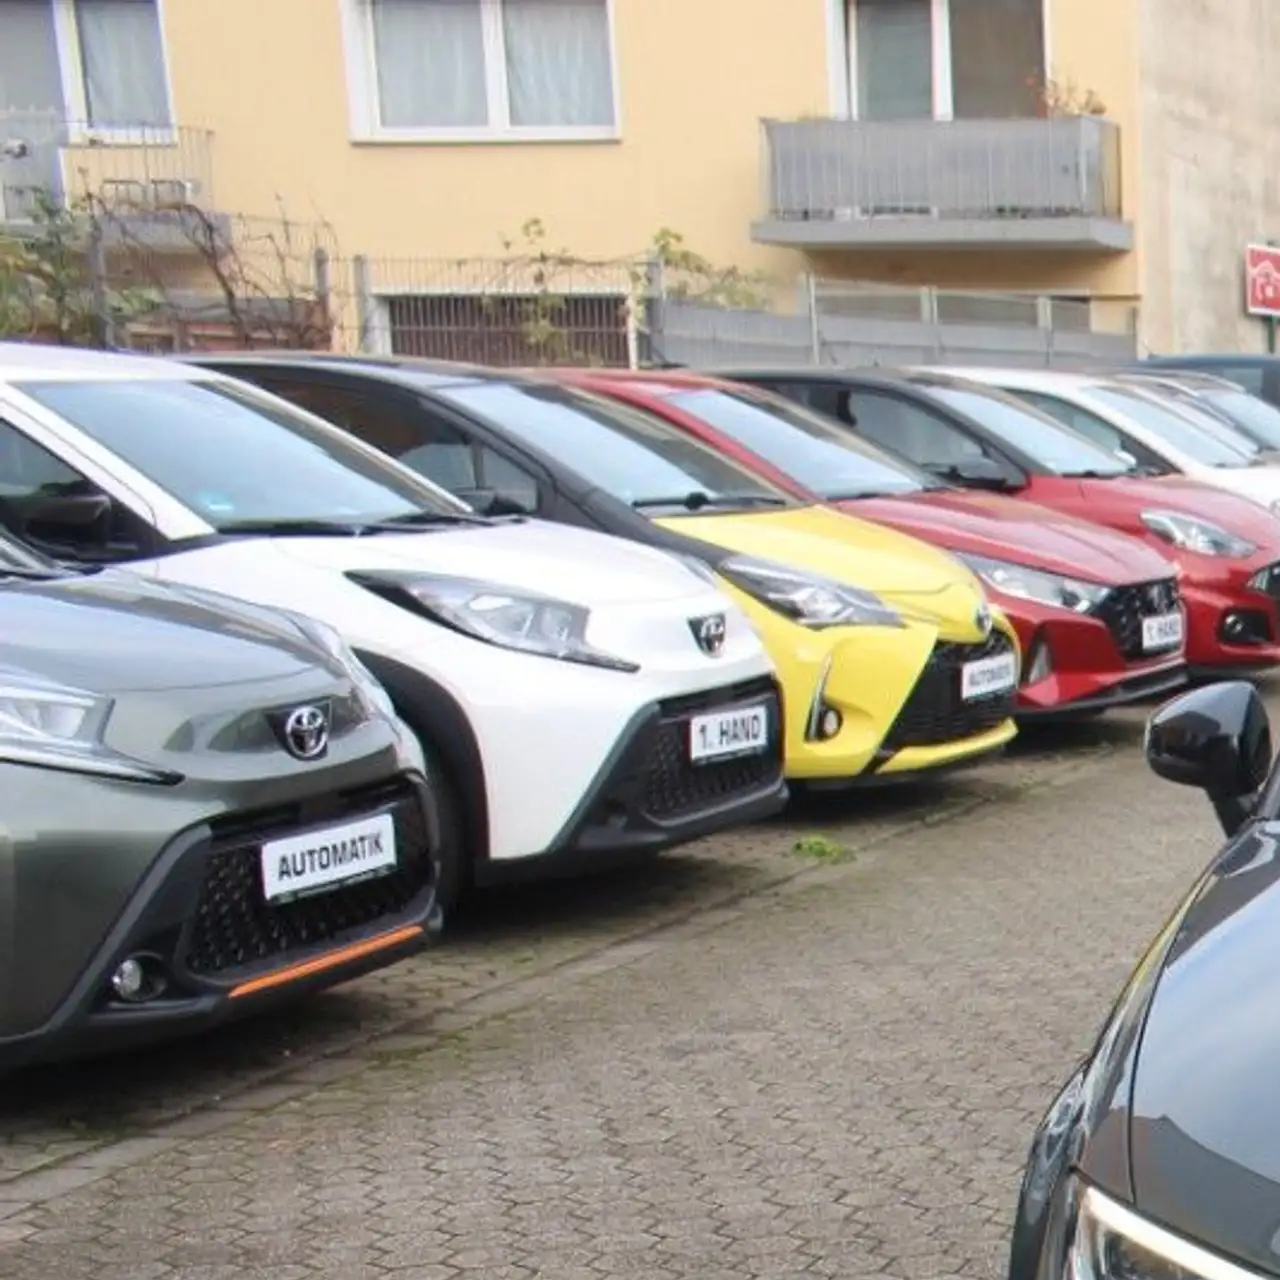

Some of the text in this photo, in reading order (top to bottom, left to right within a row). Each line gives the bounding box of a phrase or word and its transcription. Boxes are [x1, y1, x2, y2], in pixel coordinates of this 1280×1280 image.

[699, 714, 760, 750] 1. HAND
[278, 831, 384, 881] AUTOMATIK
